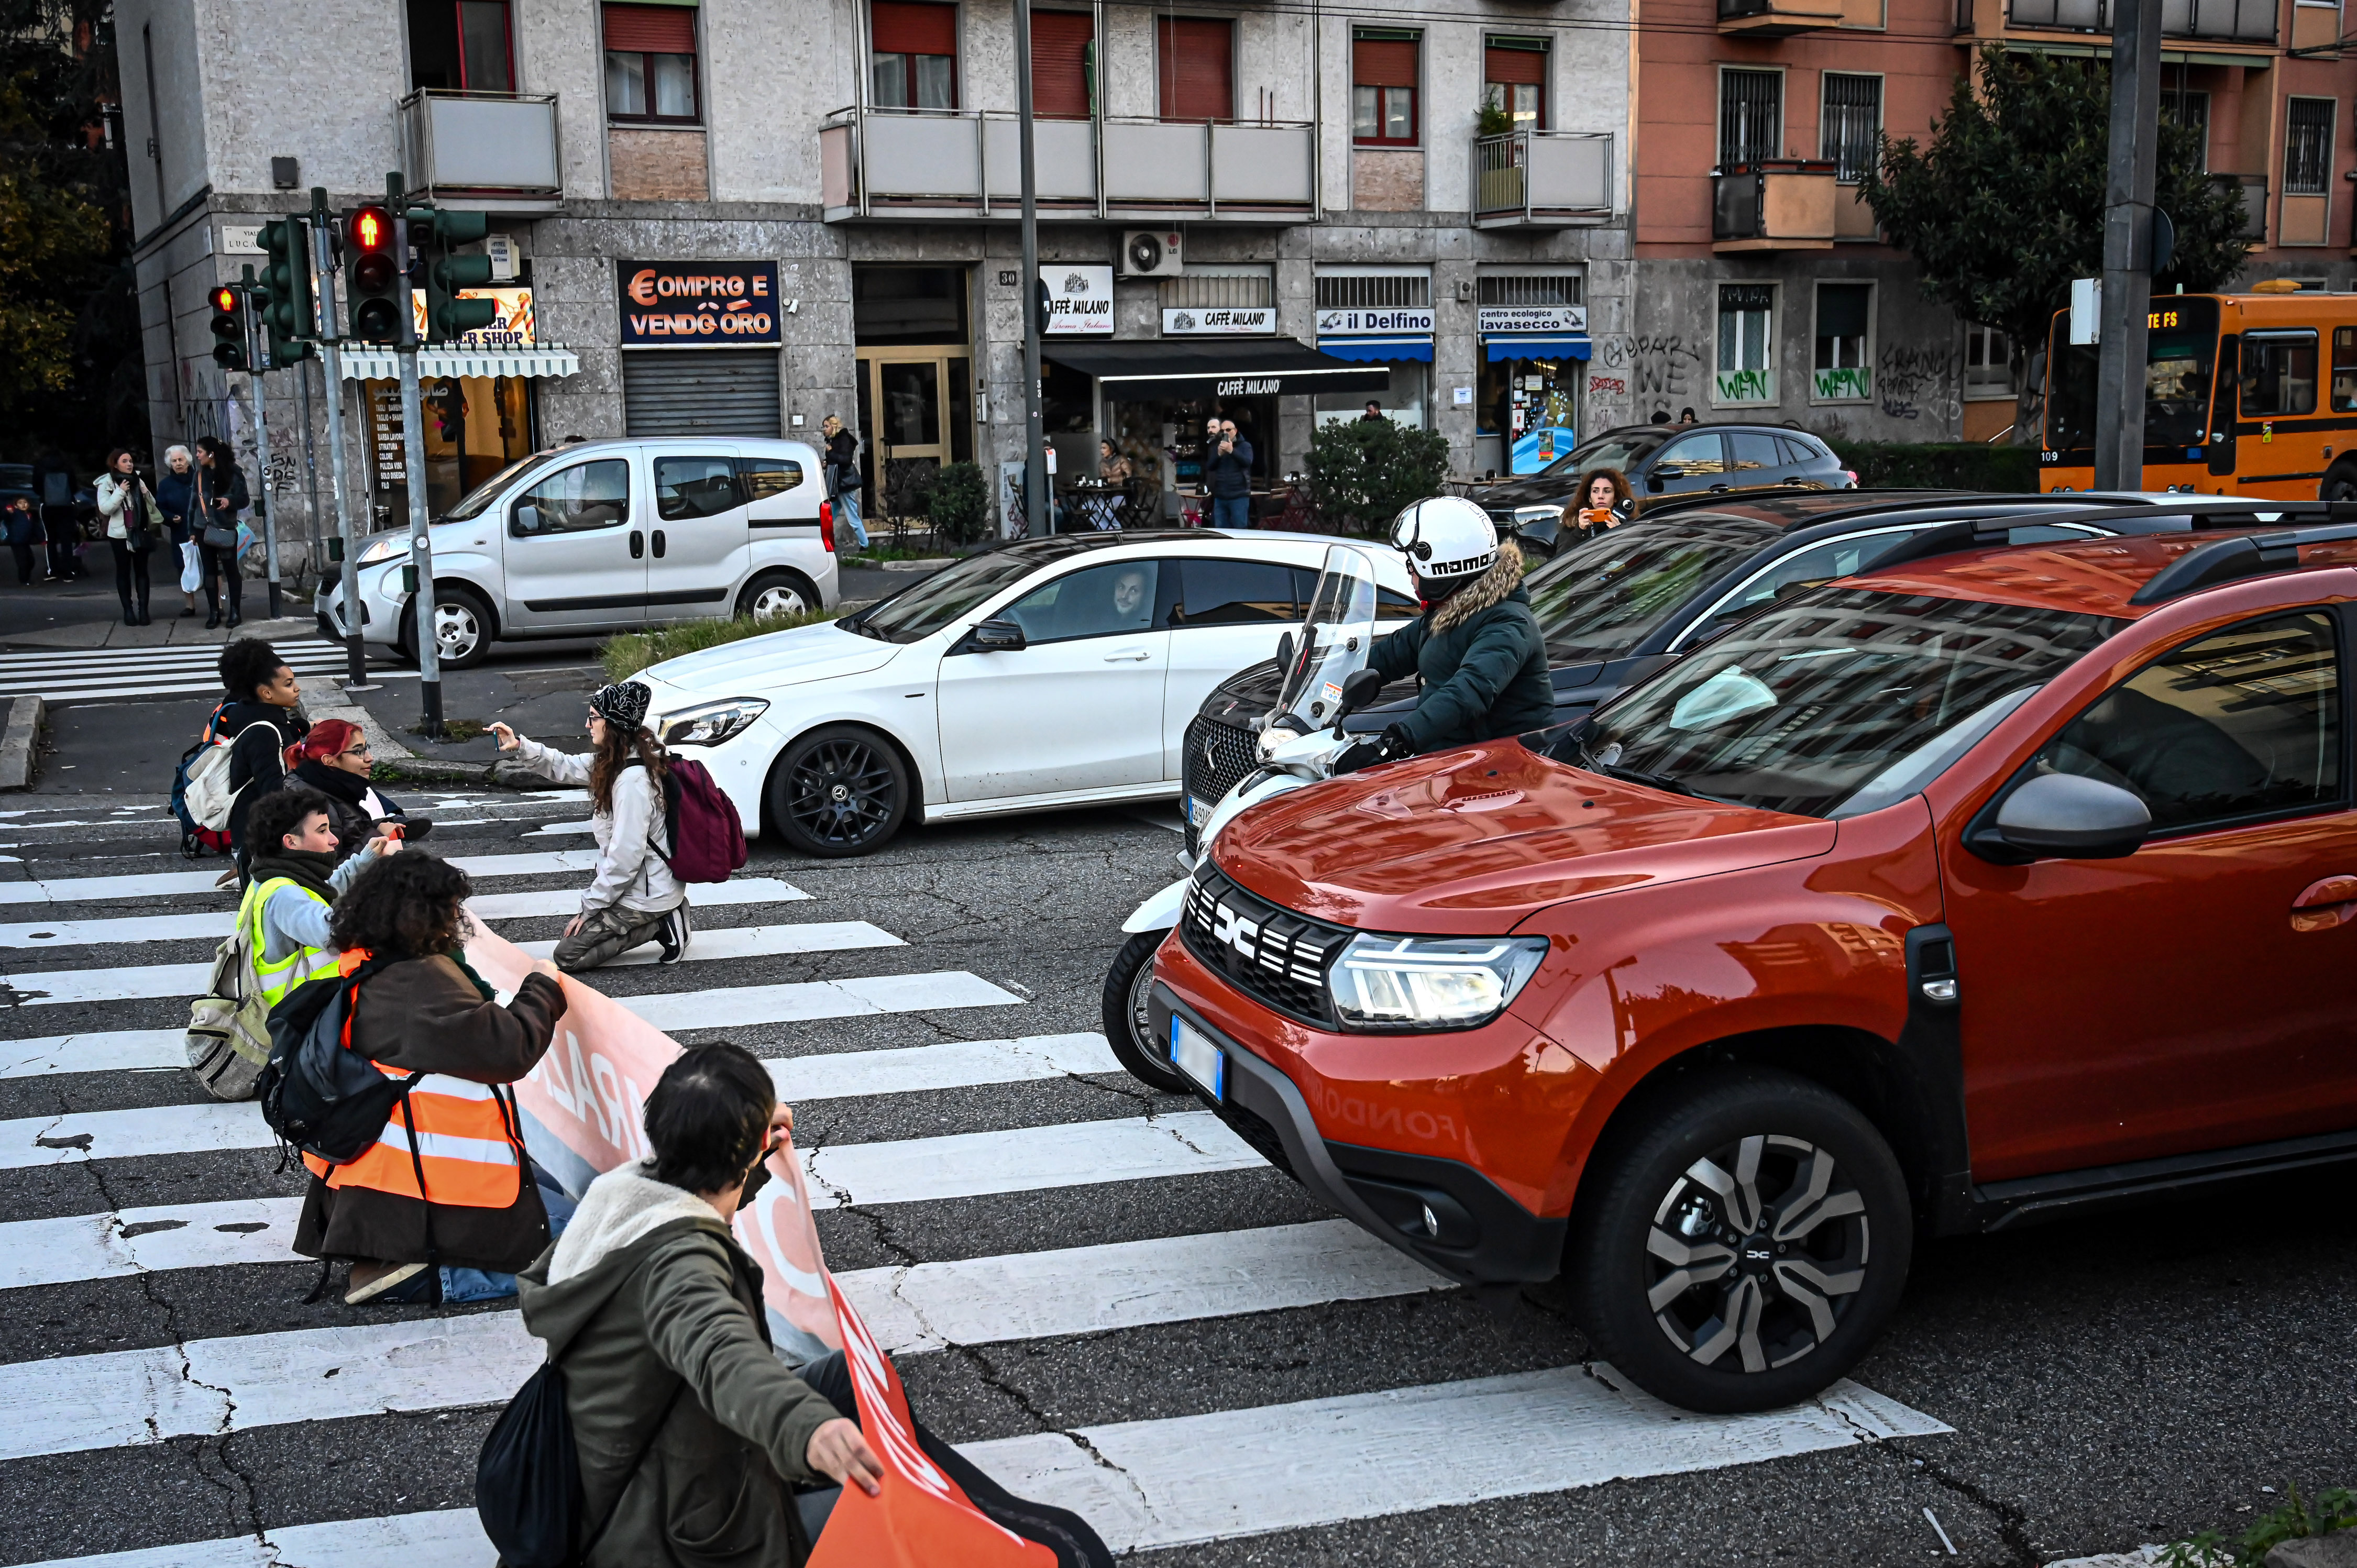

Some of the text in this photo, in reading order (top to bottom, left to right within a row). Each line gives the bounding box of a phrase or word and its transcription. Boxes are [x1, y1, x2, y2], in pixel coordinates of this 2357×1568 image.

[753, 275, 768, 296] E
[1001, 272, 1015, 284] 30
[1050, 297, 1109, 314] AFFÈ MILANO
[1205, 310, 1264, 326] CAFFÈ MILANO
[1348, 312, 1431, 329] il Delfino
[1511, 310, 1552, 318] ecologico
[2147, 311, 2177, 328] TE FS
[720, 313, 772, 334] ORO
[1480, 319, 1560, 329] lavasecco
[482, 332, 523, 344] SHOP
[1217, 378, 1280, 396] CAFFÈ MILANO
[2041, 451, 2058, 461] 109
